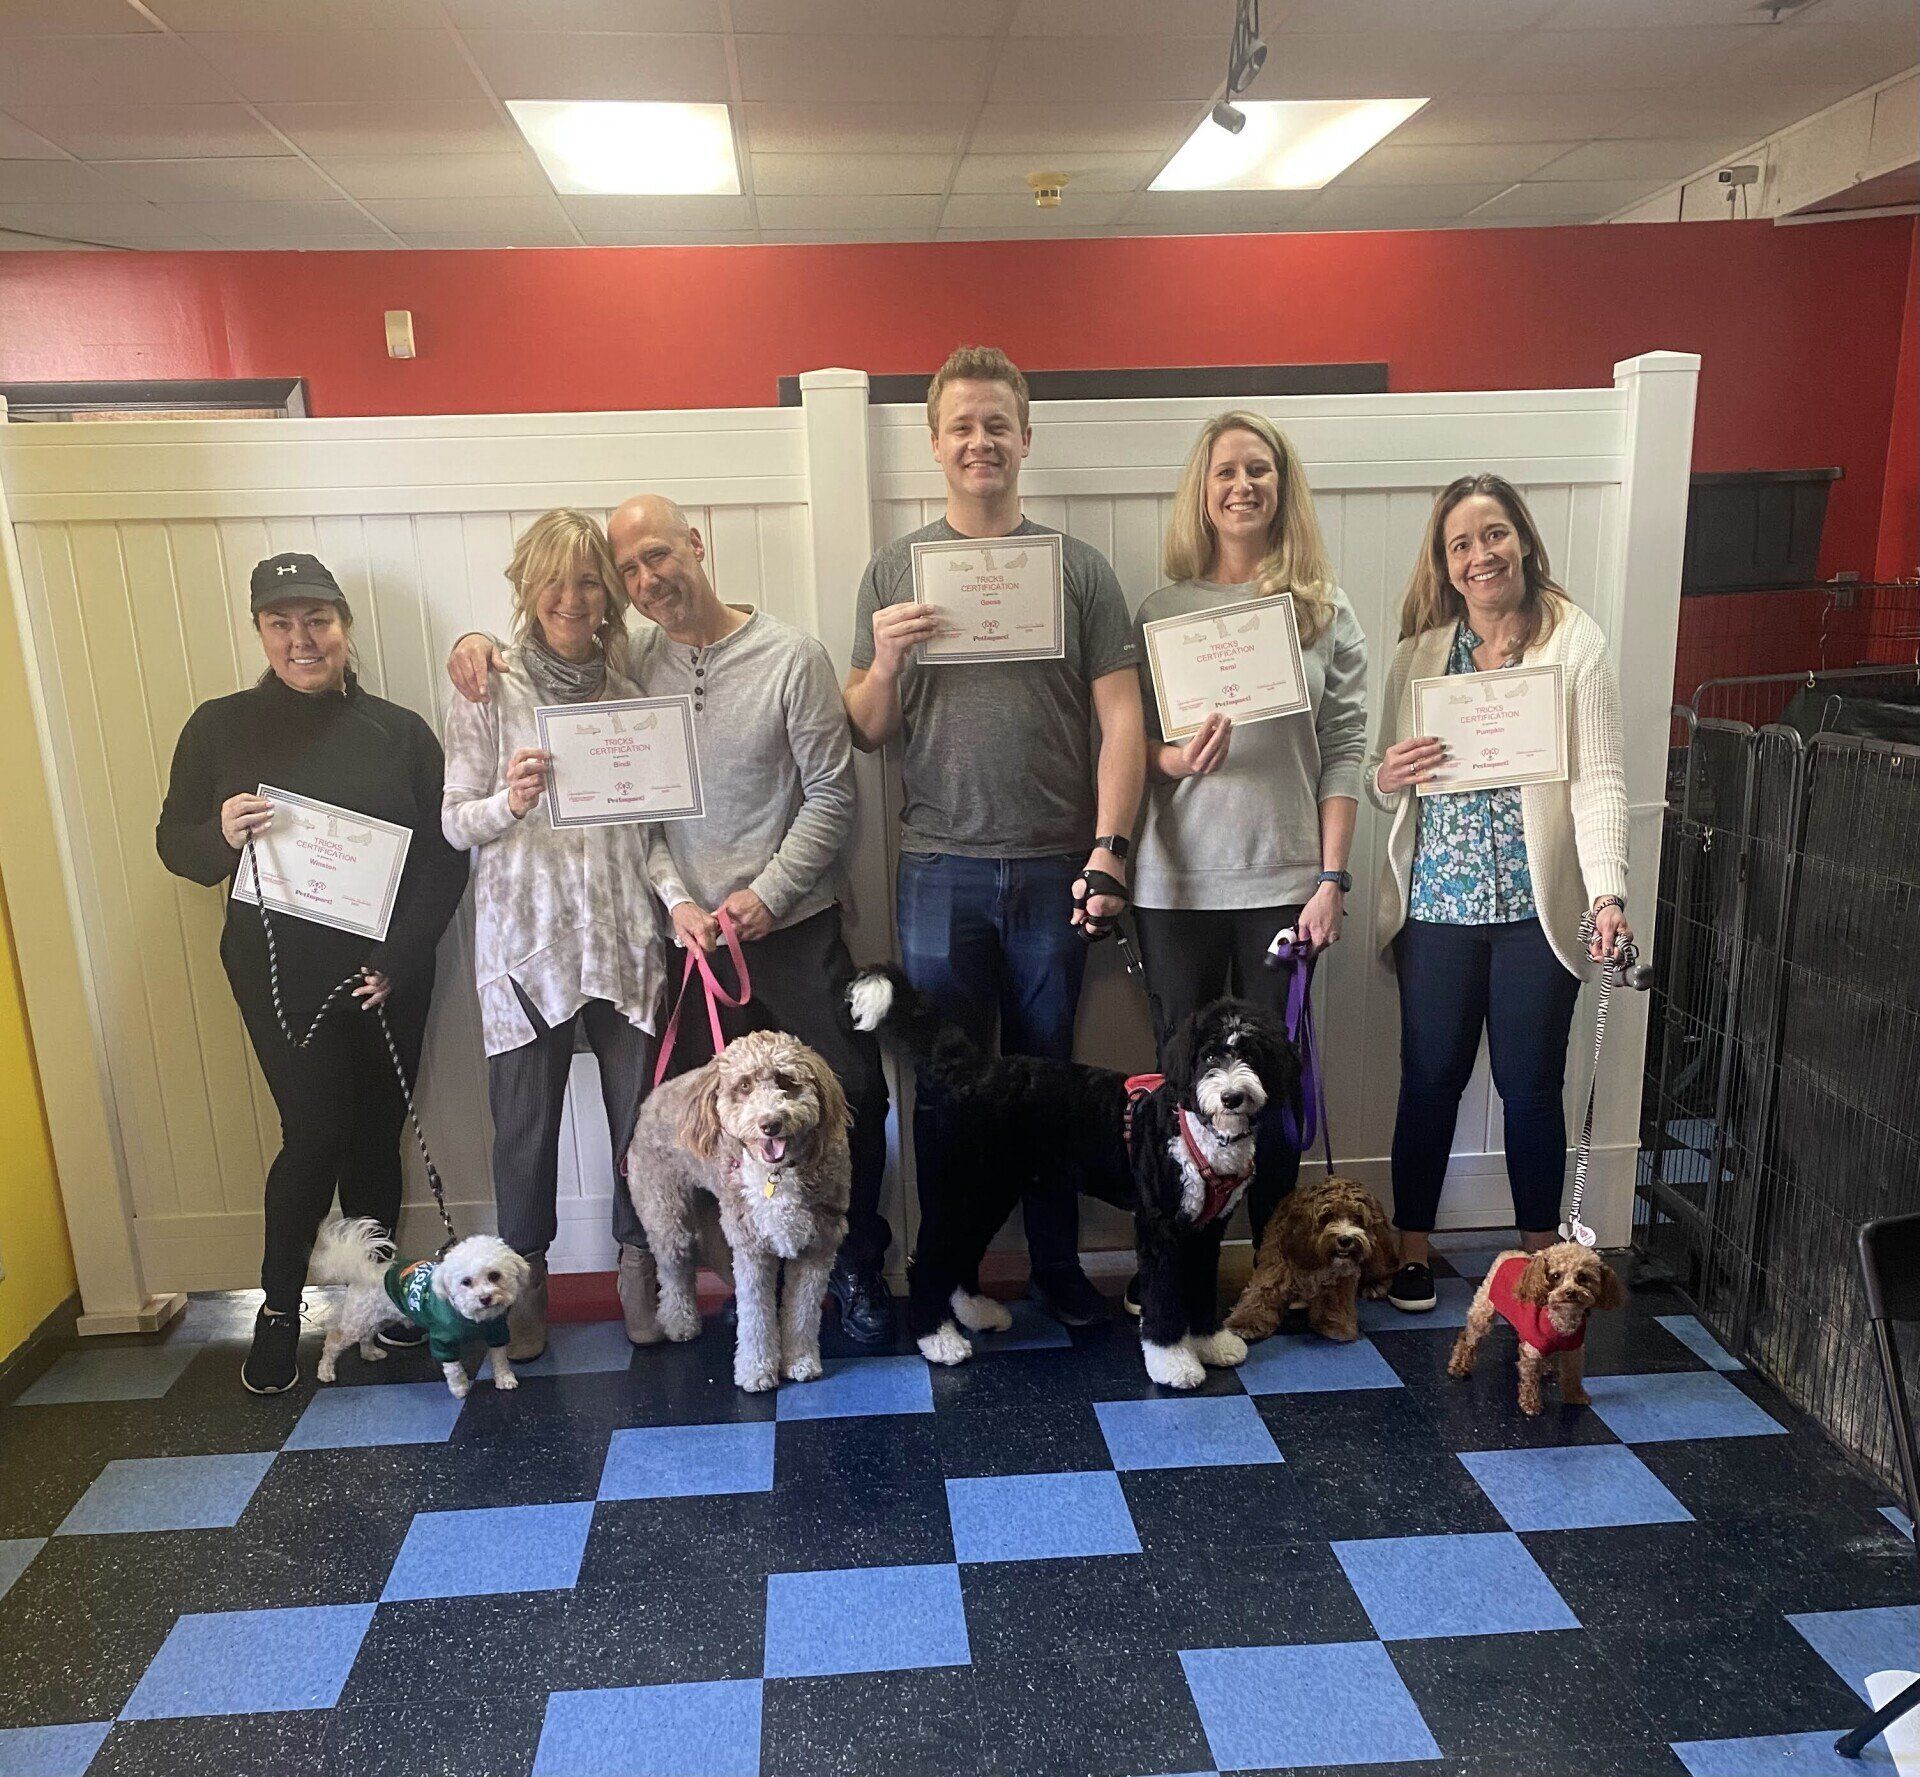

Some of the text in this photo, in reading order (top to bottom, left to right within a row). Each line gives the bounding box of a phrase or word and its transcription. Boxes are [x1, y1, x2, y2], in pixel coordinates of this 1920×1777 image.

[976, 575, 1004, 584] TRICKS
[961, 582, 1020, 593] CERTIFICATION
[1210, 640, 1239, 652] TRICKS
[1196, 644, 1255, 663] CERTIFICATION
[1475, 705, 1504, 715] TRICKS
[1460, 711, 1520, 724] CERTIFICATION
[1476, 727, 1505, 737] Pumpkin
[604, 737, 634, 747] TRICKS
[589, 744, 651, 756] CERTIFICATION
[314, 836, 343, 851] TRICKS
[296, 839, 357, 863] CERTIFICATION
[309, 857, 337, 872] Winston
